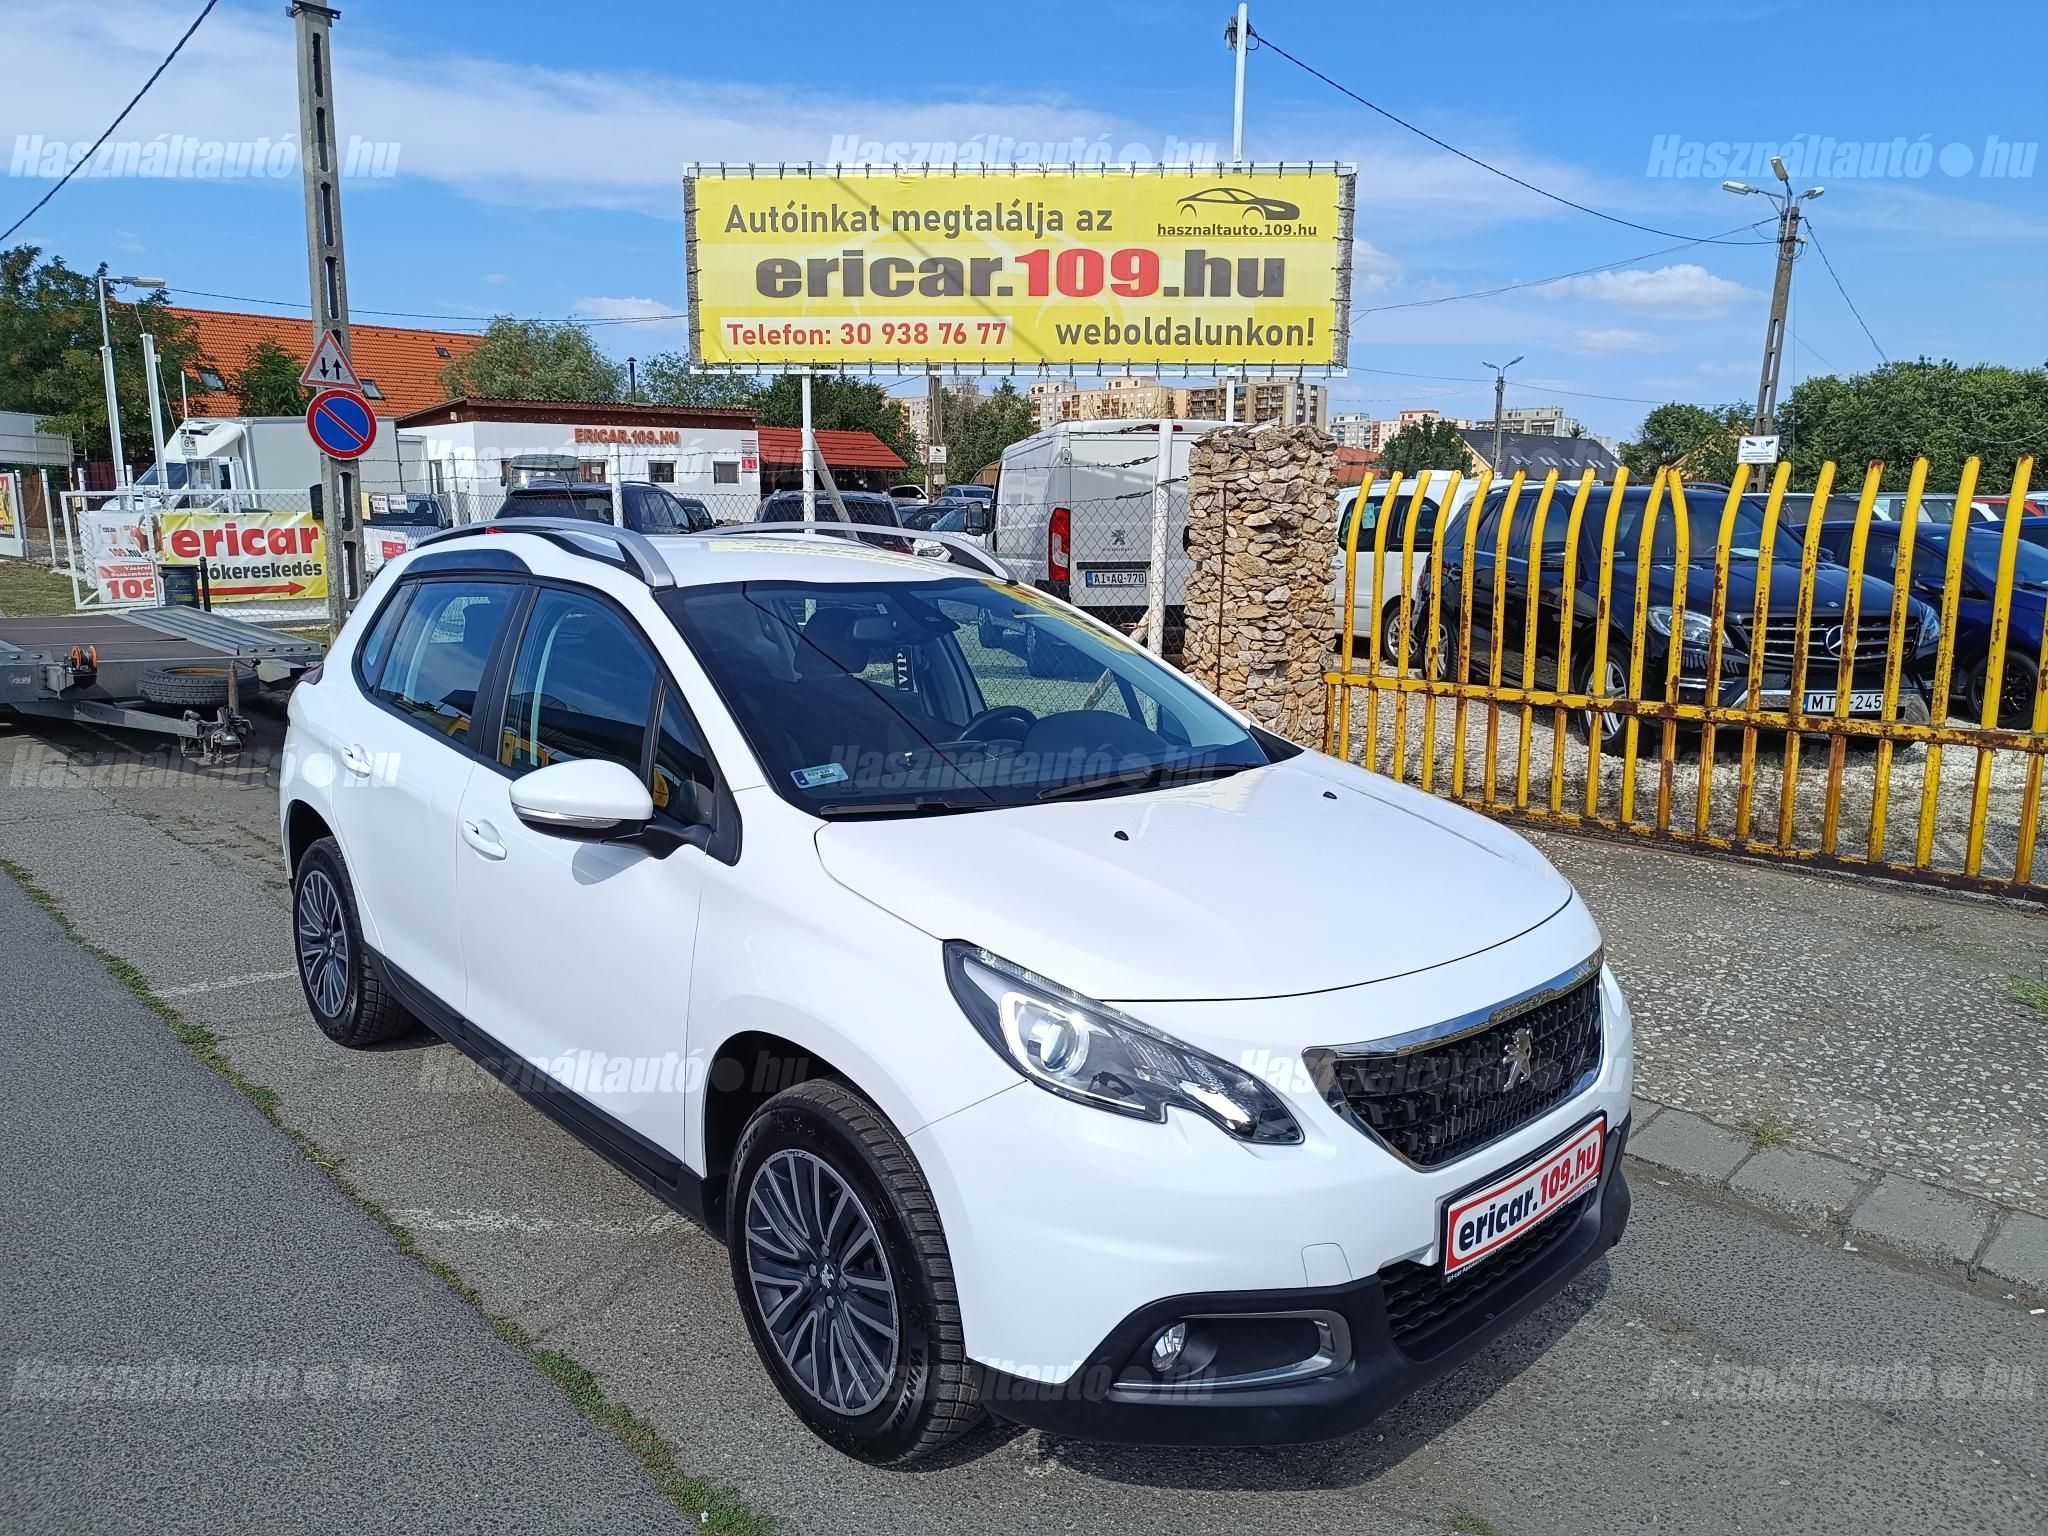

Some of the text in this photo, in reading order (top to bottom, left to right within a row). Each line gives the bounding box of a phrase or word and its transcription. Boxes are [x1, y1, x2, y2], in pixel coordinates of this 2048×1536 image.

[725, 199, 1113, 240] Autóinkat megtalálja az
[1157, 223, 1318, 236] hasznaltauto.109.hu
[755, 248, 1284, 299] ericar.109.hu
[727, 323, 1007, 346] Telefon: 30 938 76 77
[1056, 317, 1315, 347] weboldalunkon!
[575, 428, 680, 444] ERICAR.109.HU
[171, 522, 319, 558] ericar
[1811, 695, 1882, 710] MT-245
[1459, 1141, 1598, 1251] ericar.109.hu
